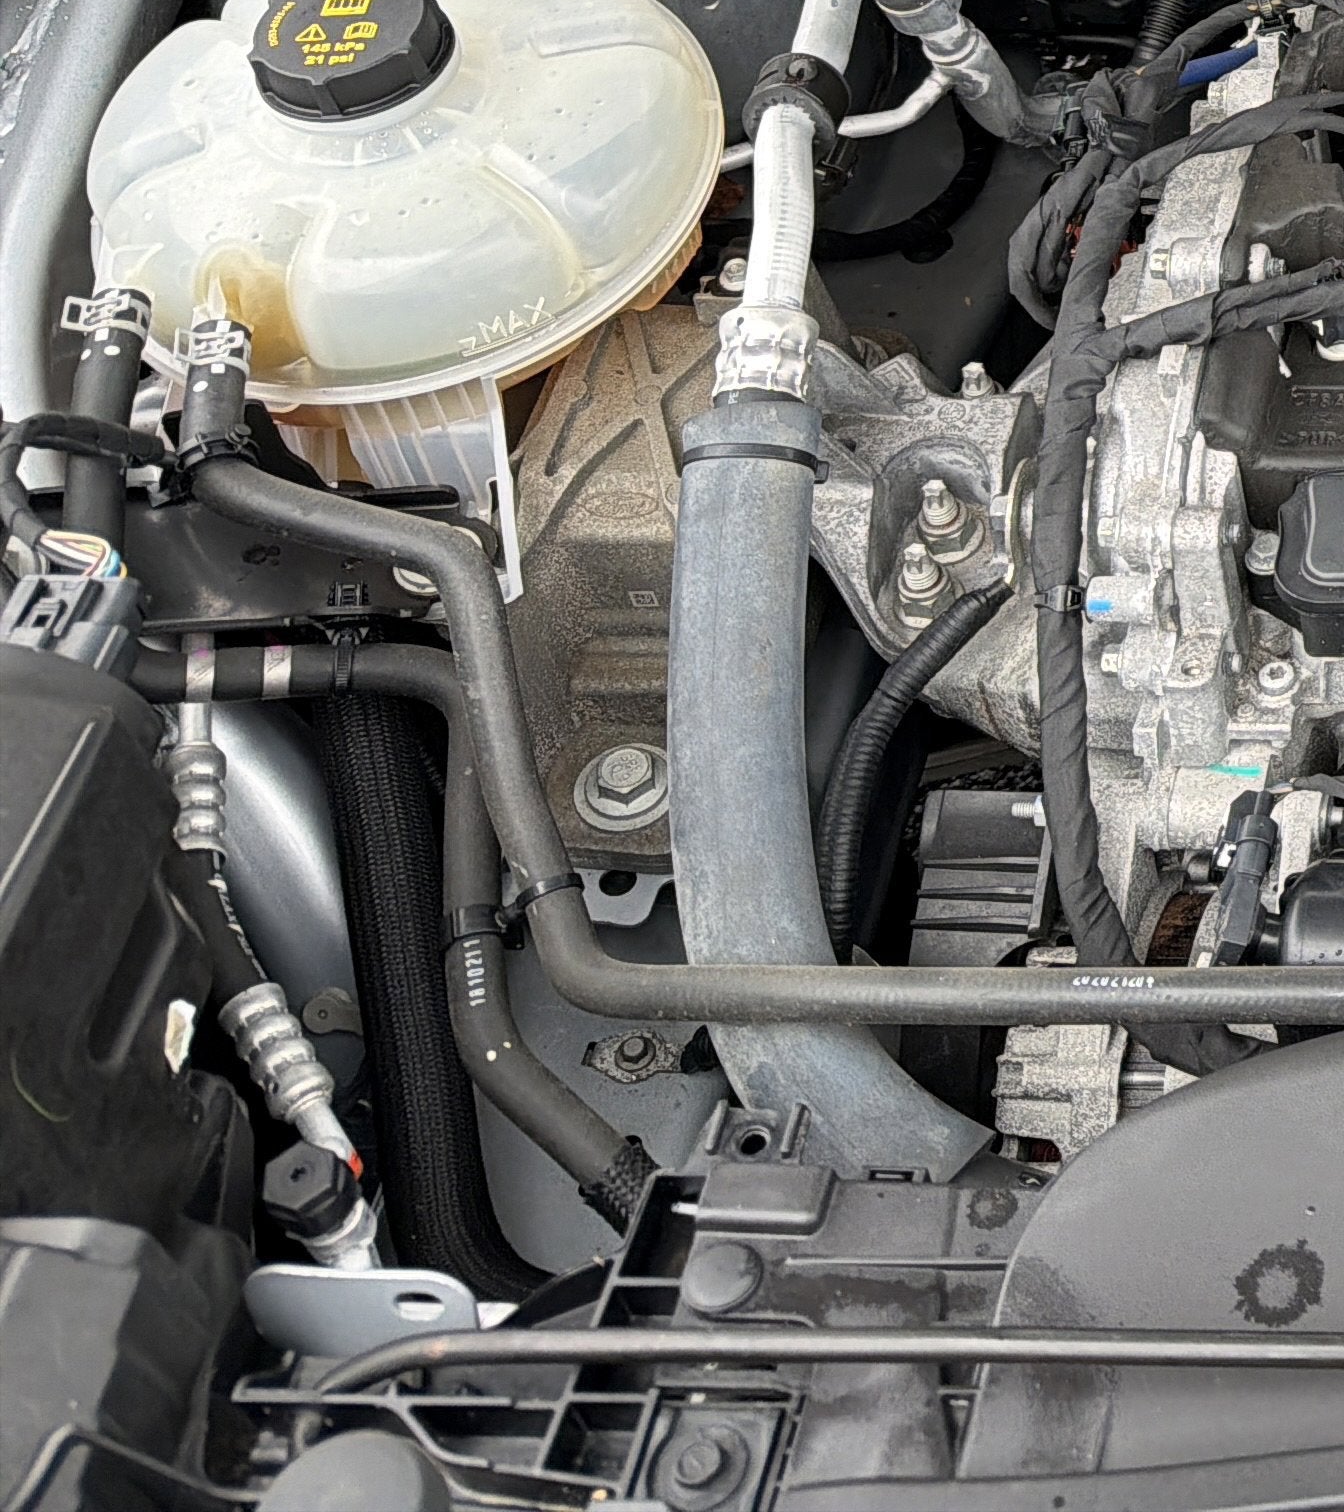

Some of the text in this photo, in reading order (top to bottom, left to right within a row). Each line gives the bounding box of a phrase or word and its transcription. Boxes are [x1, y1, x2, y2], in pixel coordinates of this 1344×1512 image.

[304, 51, 356, 67] 21 psi
[333, 40, 366, 54] kPa
[479, 297, 552, 340] MAX
[467, 939, 486, 1007] 1810211
